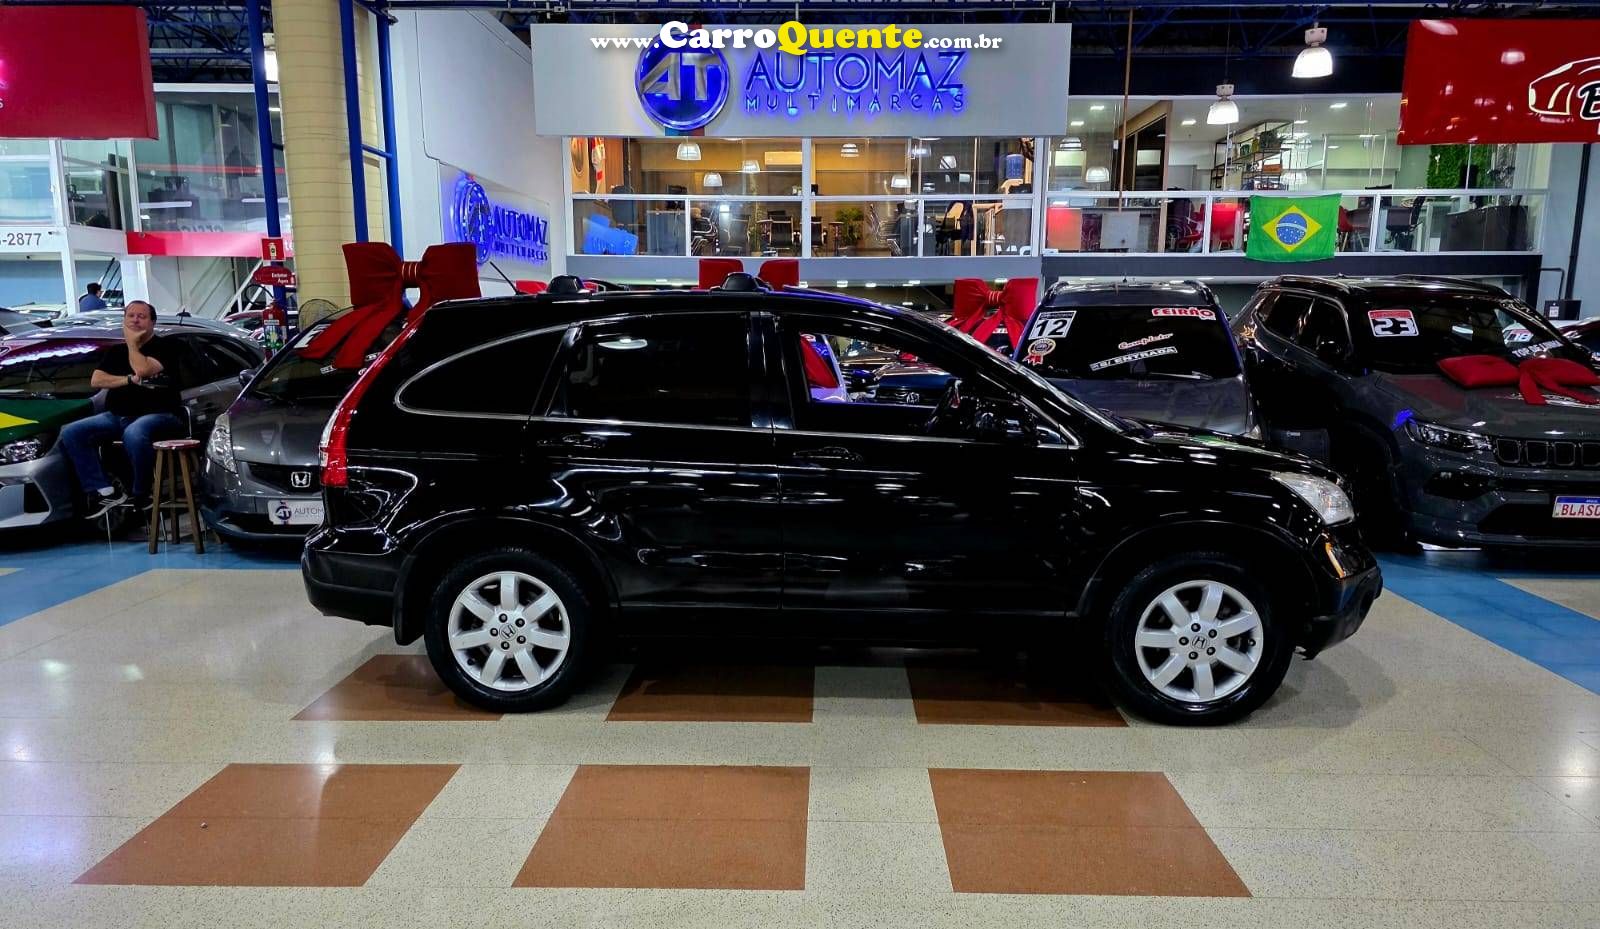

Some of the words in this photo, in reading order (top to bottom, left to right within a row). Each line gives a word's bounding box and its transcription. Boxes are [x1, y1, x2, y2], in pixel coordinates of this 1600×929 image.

[745, 50, 966, 92] AUTOMAZ
[746, 94, 964, 112] MULTIMARCAS
[492, 205, 548, 246] AUTOMAZ
[0, 232, 42, 246] -2877
[1036, 319, 1068, 337] 12
[1374, 317, 1417, 335] 23
